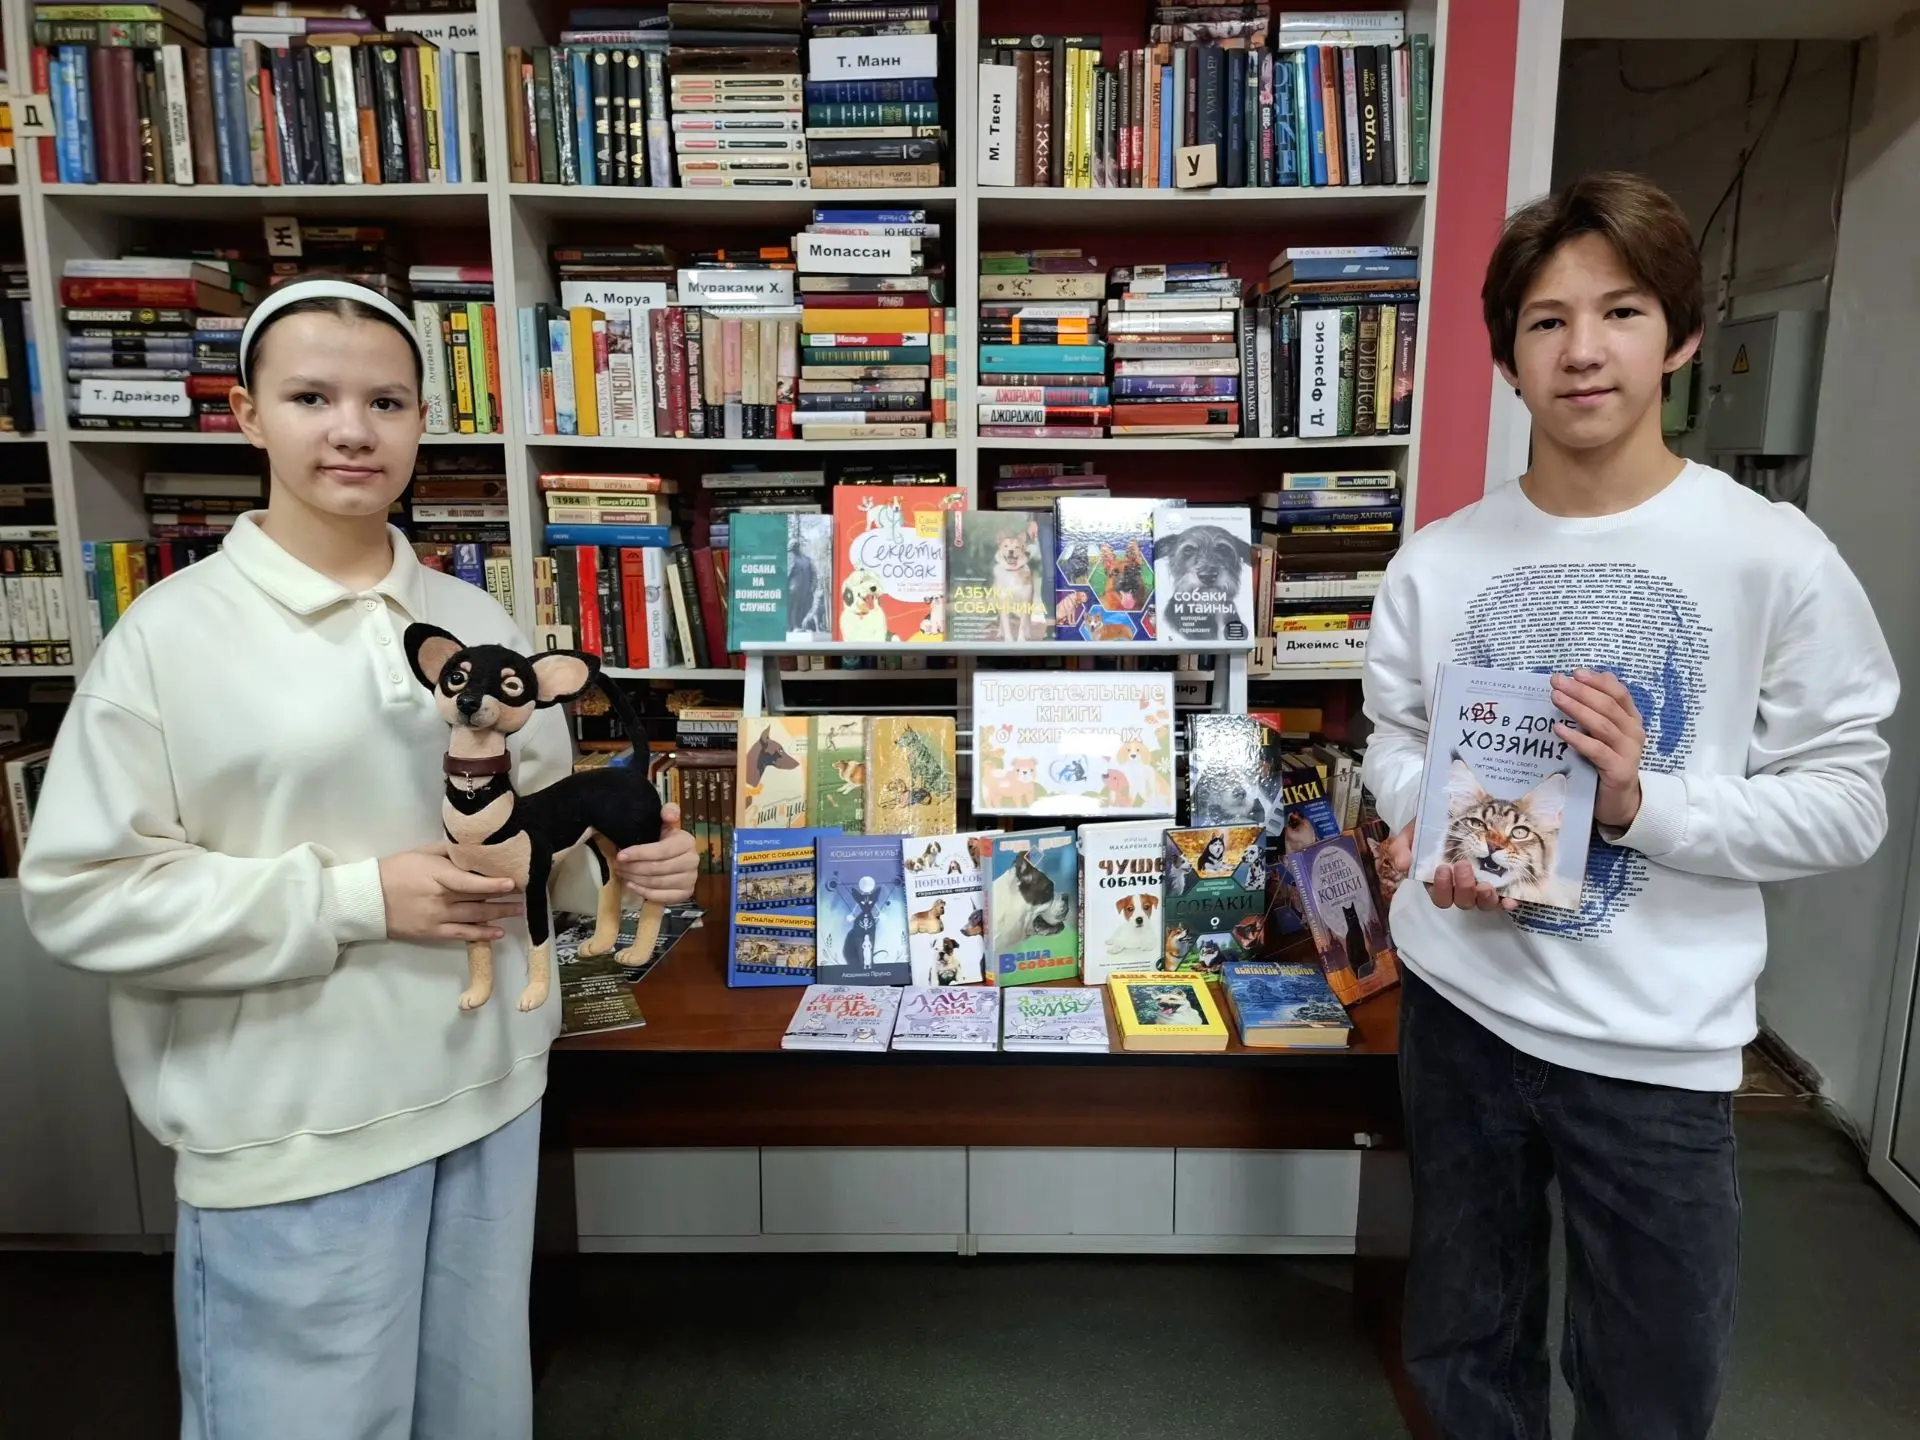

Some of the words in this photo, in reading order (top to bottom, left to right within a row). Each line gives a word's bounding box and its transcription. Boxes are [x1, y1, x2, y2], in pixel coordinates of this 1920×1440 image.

[837, 57, 852, 69] Т.
[857, 56, 901, 69] Манн
[24, 105, 44, 126] Д
[989, 94, 1002, 136] Твен
[1364, 104, 1376, 161] ЧУДО
[989, 142, 1001, 161] М.
[1188, 155, 1201, 176] У
[884, 228, 895, 237] Ю
[810, 245, 892, 259] Мопассан
[688, 282, 766, 294] Мураками
[769, 283, 785, 294] Х.
[584, 293, 600, 304] А.
[604, 293, 652, 308] Моруа
[837, 334, 869, 344] Мольер
[1244, 326, 1256, 378] ИСТОРИЯ
[1311, 321, 1327, 403] Фрэнсис
[94, 390, 107, 401] Т.
[113, 390, 180, 403] Драйзер
[612, 367, 635, 421] МИТЧЕЛЛ
[1246, 380, 1257, 422] ВОЛКОВ
[1310, 408, 1325, 427] Д.
[557, 496, 580, 506] 1984
[620, 496, 647, 508] ОРУЭЛЛ
[861, 535, 945, 568] Секреты
[741, 564, 777, 575] СОБАКА
[882, 563, 938, 579] собак
[752, 578, 766, 587] НА
[735, 588, 782, 600] ВОИНСКОЙ
[1175, 588, 1229, 603] собаки
[739, 602, 777, 613] СЛУЖБЕ
[1175, 605, 1186, 614] и
[1188, 602, 1237, 616] тайны,
[1285, 640, 1340, 652] Джеймс
[1345, 638, 1369, 650] Че
[1470, 680, 1516, 690] АЛЕКСАНДРА
[981, 680, 1165, 707] Трогательные
[1036, 705, 1102, 723] книги
[996, 729, 1011, 744] о
[1458, 728, 1570, 762] ХОЗЯИН?
[743, 853, 771, 862] ДИАЛОГ
[874, 849, 899, 857] КУЛЬТ
[1319, 858, 1346, 875] ДЕВЯТЬ
[915, 877, 961, 889] ПОРОДЫ
[1320, 867, 1353, 886] ЖИЗНЕЙ
[1317, 876, 1363, 904] КОШКИ
[1176, 895, 1253, 916] СОБАКИ
[741, 916, 775, 924] СИГНАЛЫ
[999, 949, 1052, 974] Ваша
[1017, 956, 1076, 972] собака
